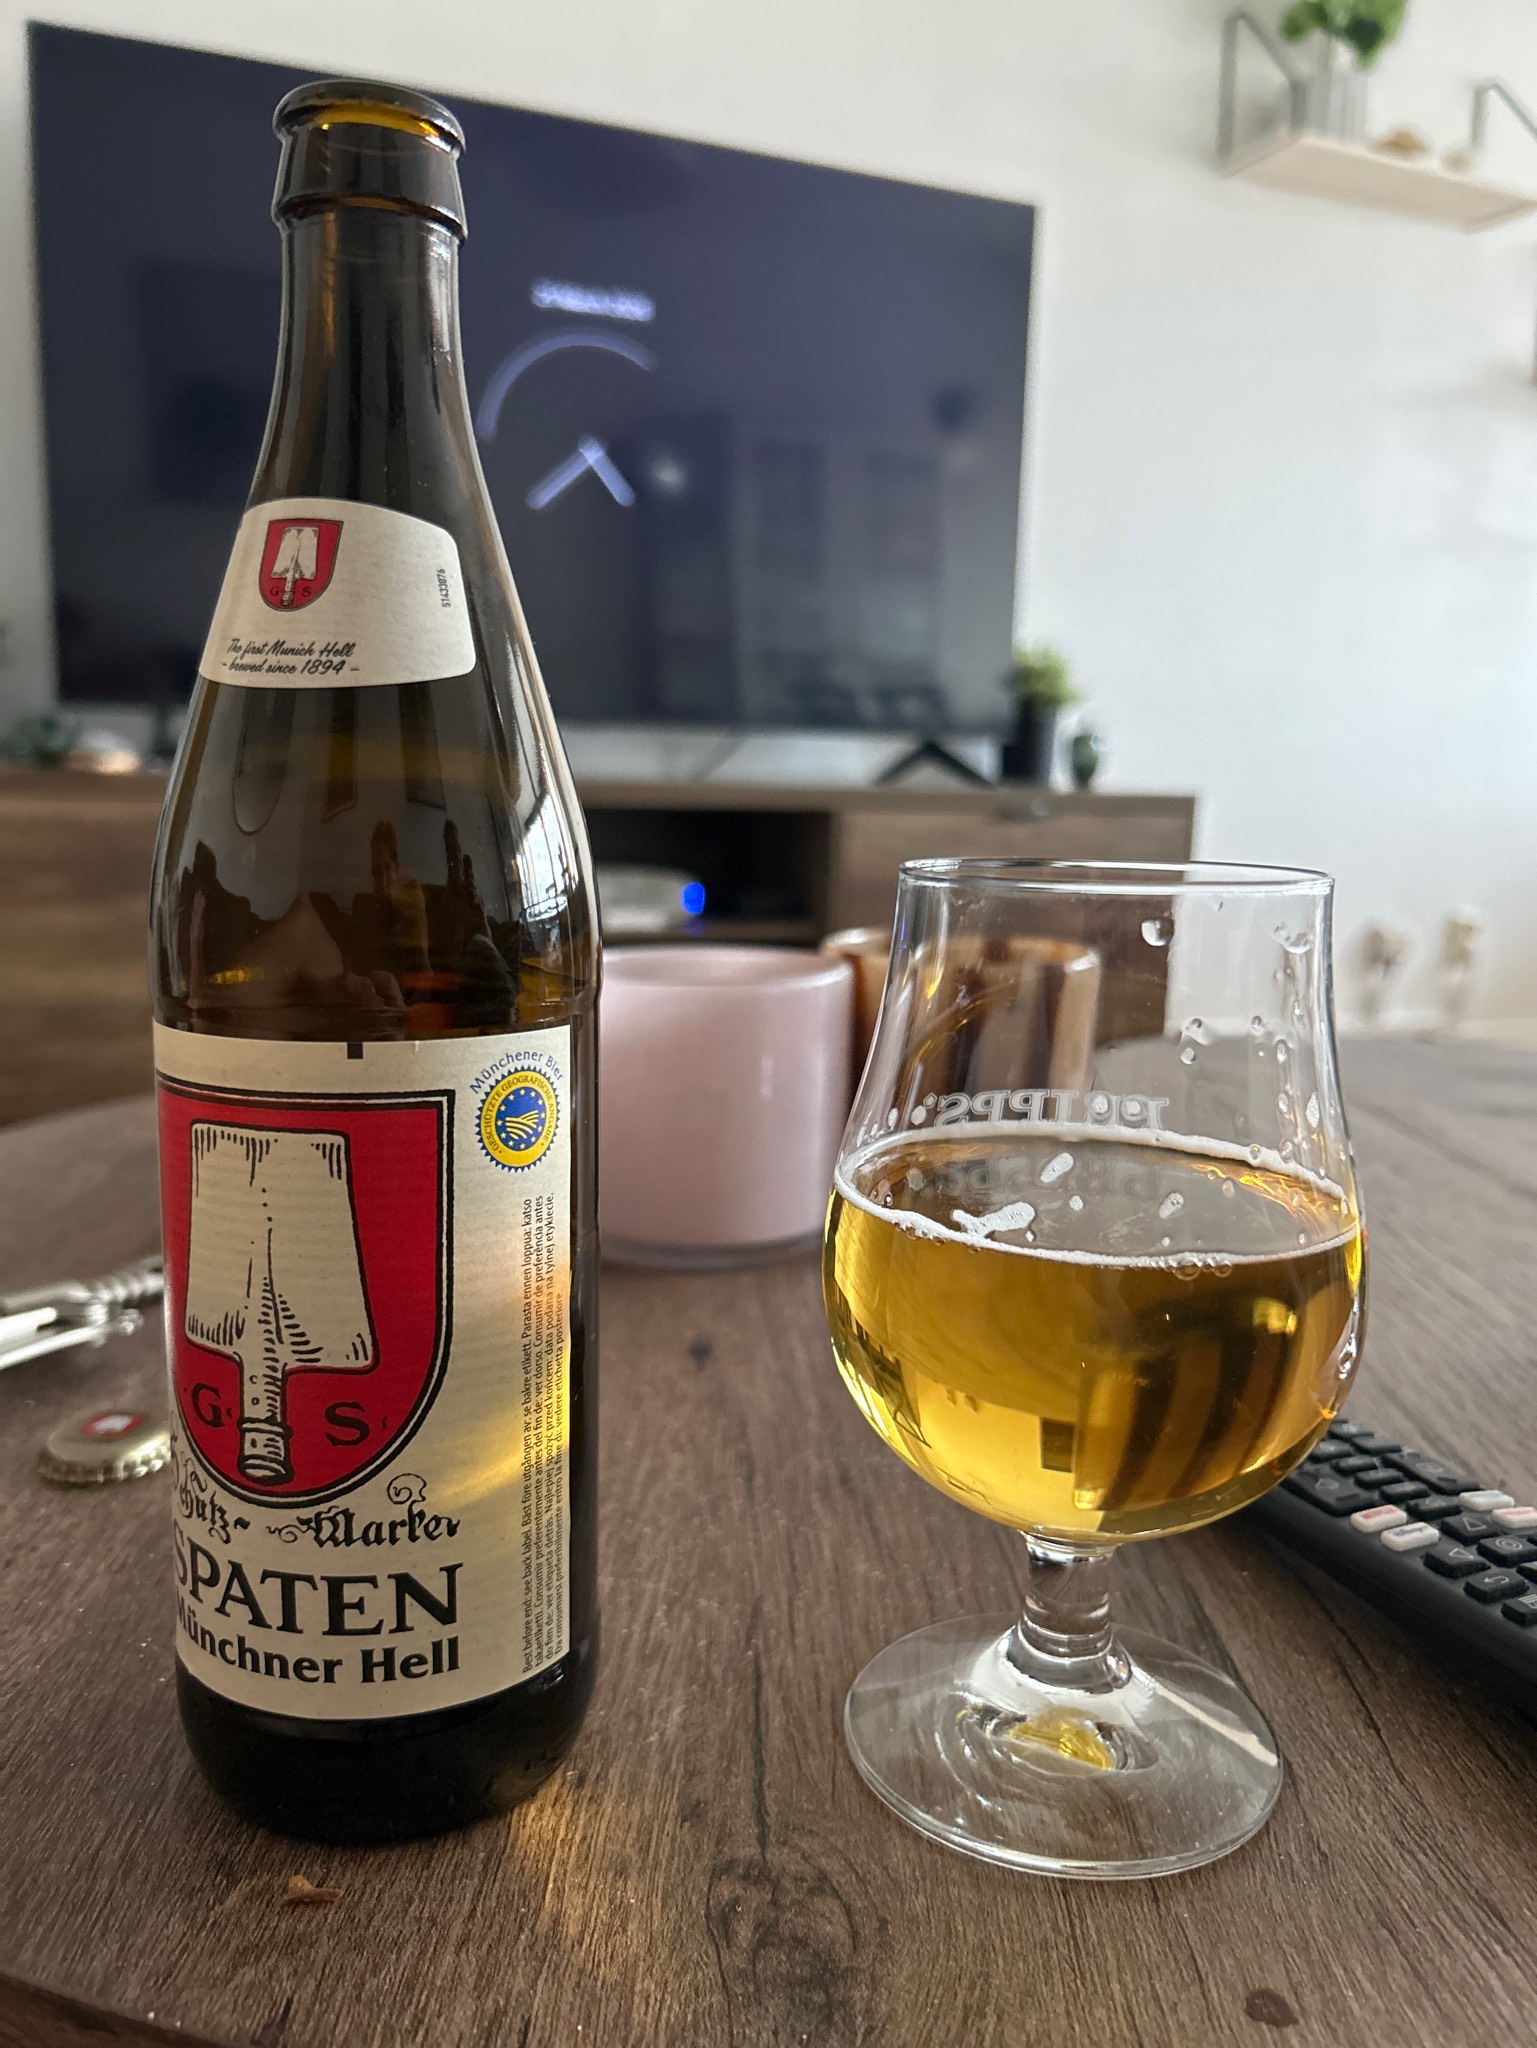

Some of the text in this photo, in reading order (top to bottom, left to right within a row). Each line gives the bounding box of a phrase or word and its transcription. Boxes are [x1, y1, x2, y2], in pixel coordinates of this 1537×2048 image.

[227, 638, 356, 660] The first Munich Hell
[229, 656, 266, 672] brewed
[266, 659, 297, 674] since
[300, 659, 346, 675] 1894
[470, 1051, 563, 1094] Münchener Bier
[521, 1199, 531, 1227] katso
[544, 1193, 555, 1242] etykiecie.
[521, 1228, 534, 1266] loppua:
[533, 1226, 544, 1282] preferência
[545, 1244, 555, 1274] tylnej
[533, 1285, 543, 1297] de
[546, 1276, 553, 1289] na
[522, 1302, 532, 1338] Parasta
[534, 1300, 543, 1347] Consumir
[545, 1292, 555, 1330] podana
[522, 1340, 531, 1374] etikett.
[545, 1332, 553, 1355] data
[533, 1348, 543, 1379] dorso.
[555, 1346, 563, 1391] etichetta
[521, 1377, 531, 1405] bakre
[323, 1401, 370, 1446] S
[524, 1406, 531, 1417] se
[533, 1416, 542, 1430] fin
[544, 1403, 554, 1431] przed
[533, 1431, 543, 1447] del
[521, 1434, 534, 1482] utgången
[535, 1449, 543, 1476] antes
[555, 1465, 562, 1476] la
[521, 1483, 531, 1503] före
[544, 1468, 554, 1513] Najlepiej
[521, 1504, 532, 1526] Bäst
[534, 1478, 545, 1560] preferentemente
[522, 1526, 532, 1554] label.
[174, 1518, 464, 1637] SPATEN
[522, 1554, 532, 1579] back
[545, 1550, 554, 1590] etiqueta
[524, 1579, 532, 1595] see
[534, 1563, 543, 1608] Consumir
[522, 1619, 532, 1651] before
[360, 1636, 460, 1684] Hell
[523, 1652, 532, 1673] Best
